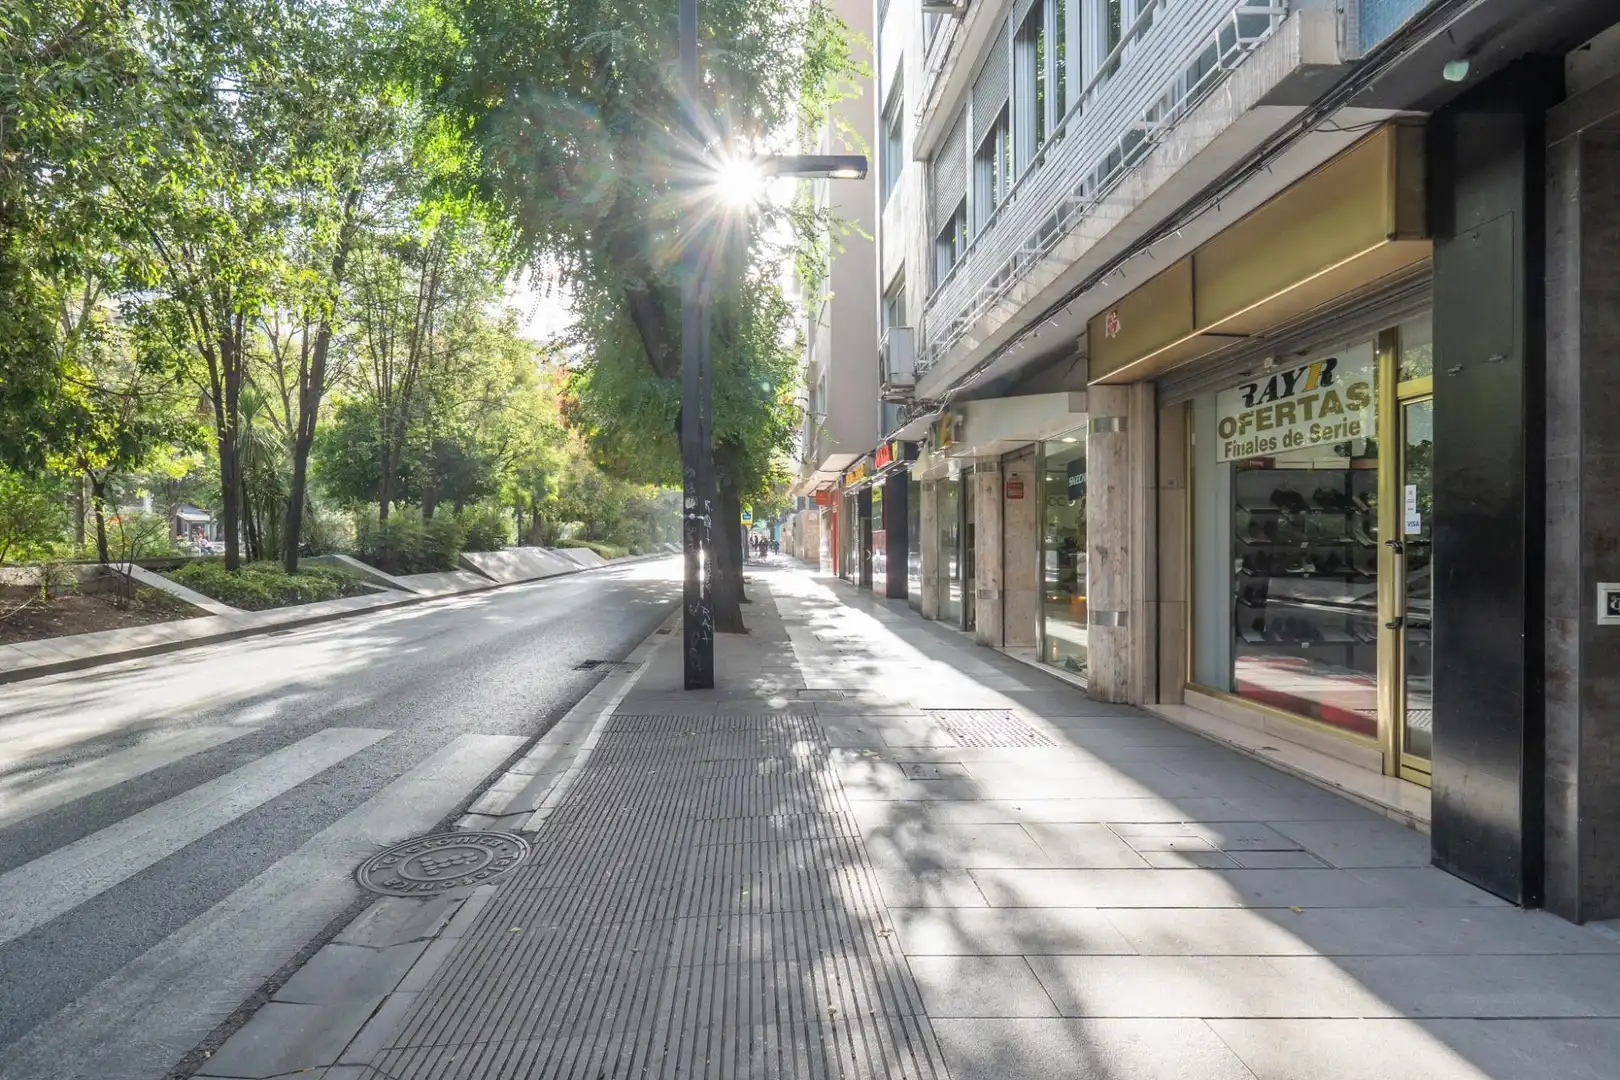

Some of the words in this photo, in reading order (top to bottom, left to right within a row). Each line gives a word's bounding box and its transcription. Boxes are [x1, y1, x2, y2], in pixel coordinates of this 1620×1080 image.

[1218, 382, 1371, 440] OFERTAS
[1224, 435, 1277, 458] Finales
[1283, 429, 1304, 449] de
[1309, 417, 1361, 444] Serie
